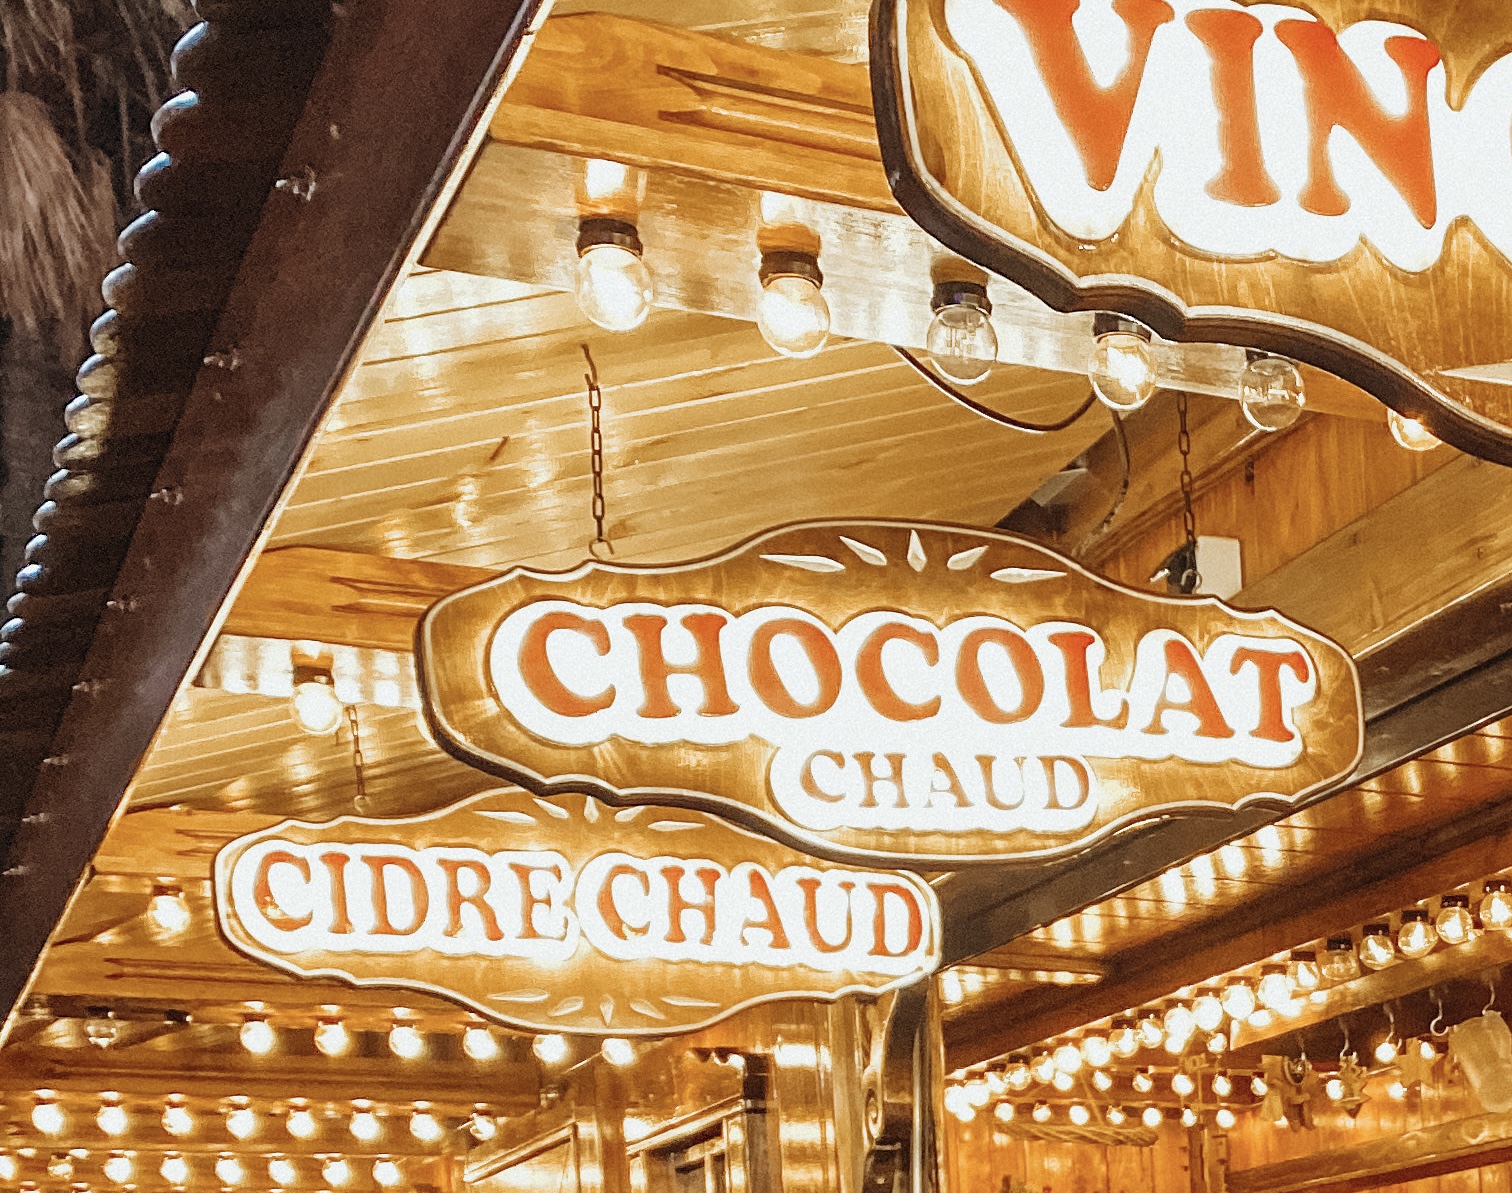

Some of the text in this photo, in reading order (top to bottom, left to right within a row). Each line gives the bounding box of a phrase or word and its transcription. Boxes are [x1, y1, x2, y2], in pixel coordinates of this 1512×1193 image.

[994, 0, 1440, 229] VIN
[517, 610, 1309, 742] CHOCOLAT
[799, 750, 1091, 812] CHAUD
[253, 850, 924, 957] CIDRE CHAUD
